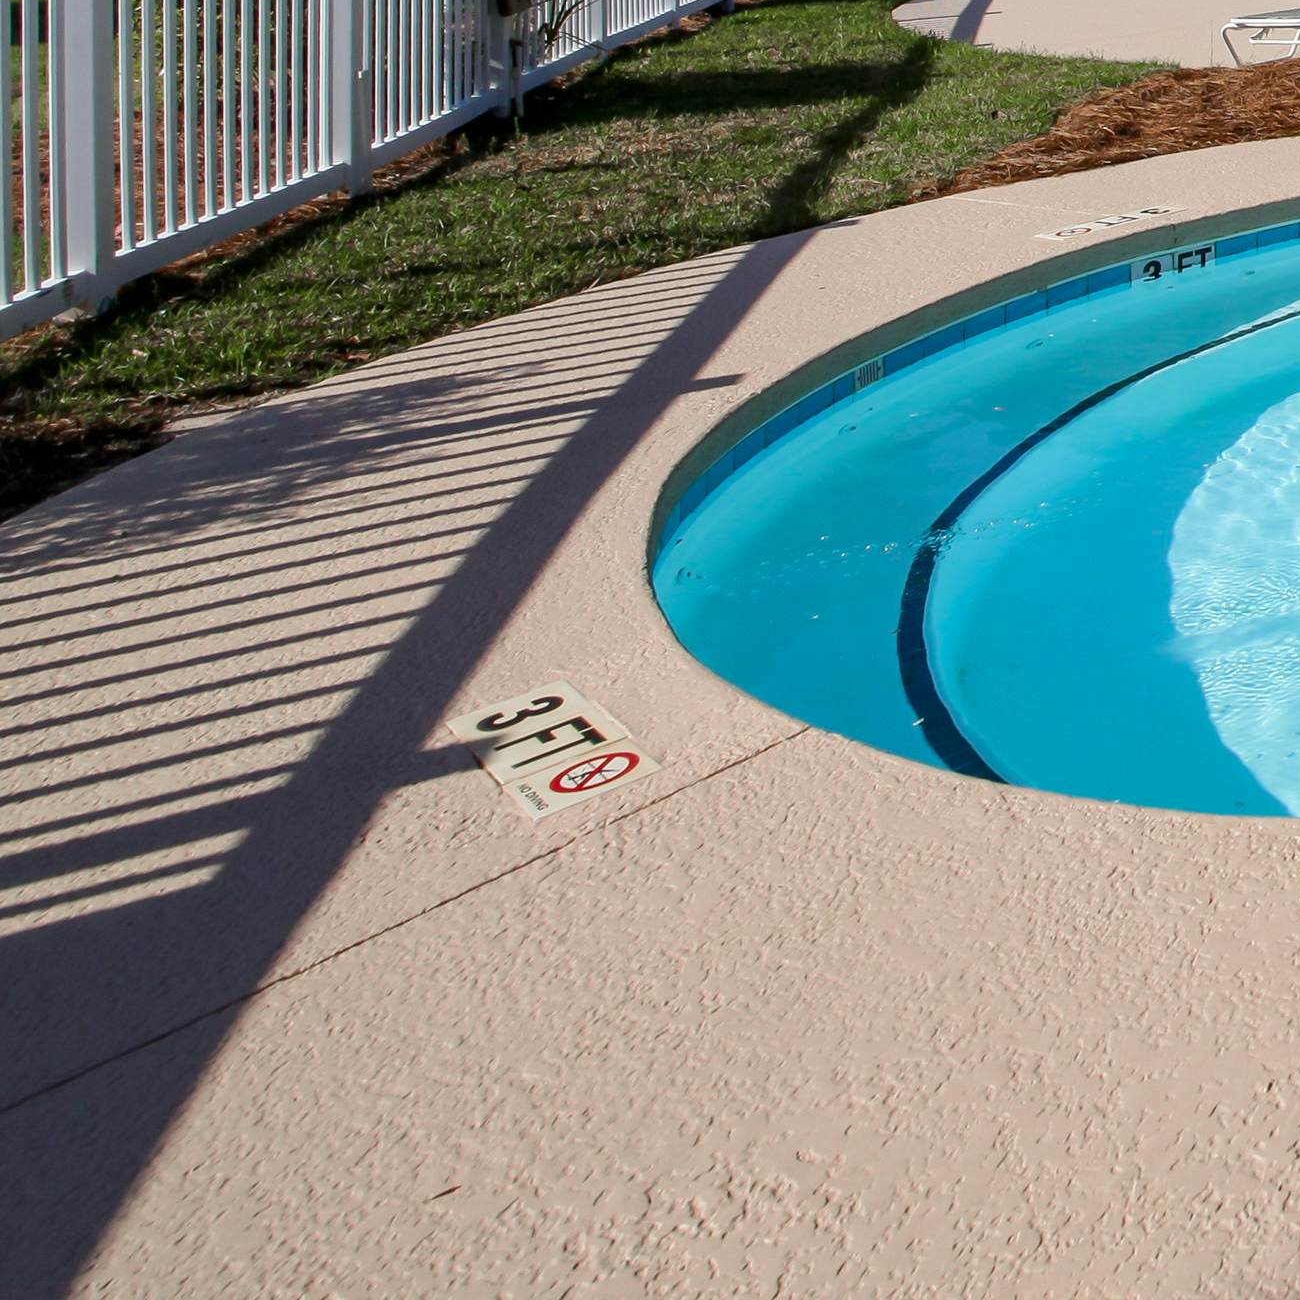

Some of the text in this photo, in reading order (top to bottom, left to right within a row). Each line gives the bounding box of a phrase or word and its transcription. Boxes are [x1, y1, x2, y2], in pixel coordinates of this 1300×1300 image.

[1142, 246, 1213, 282] 3 FT
[476, 696, 608, 769] 3 FT
[518, 783, 549, 811] NO DIVING
